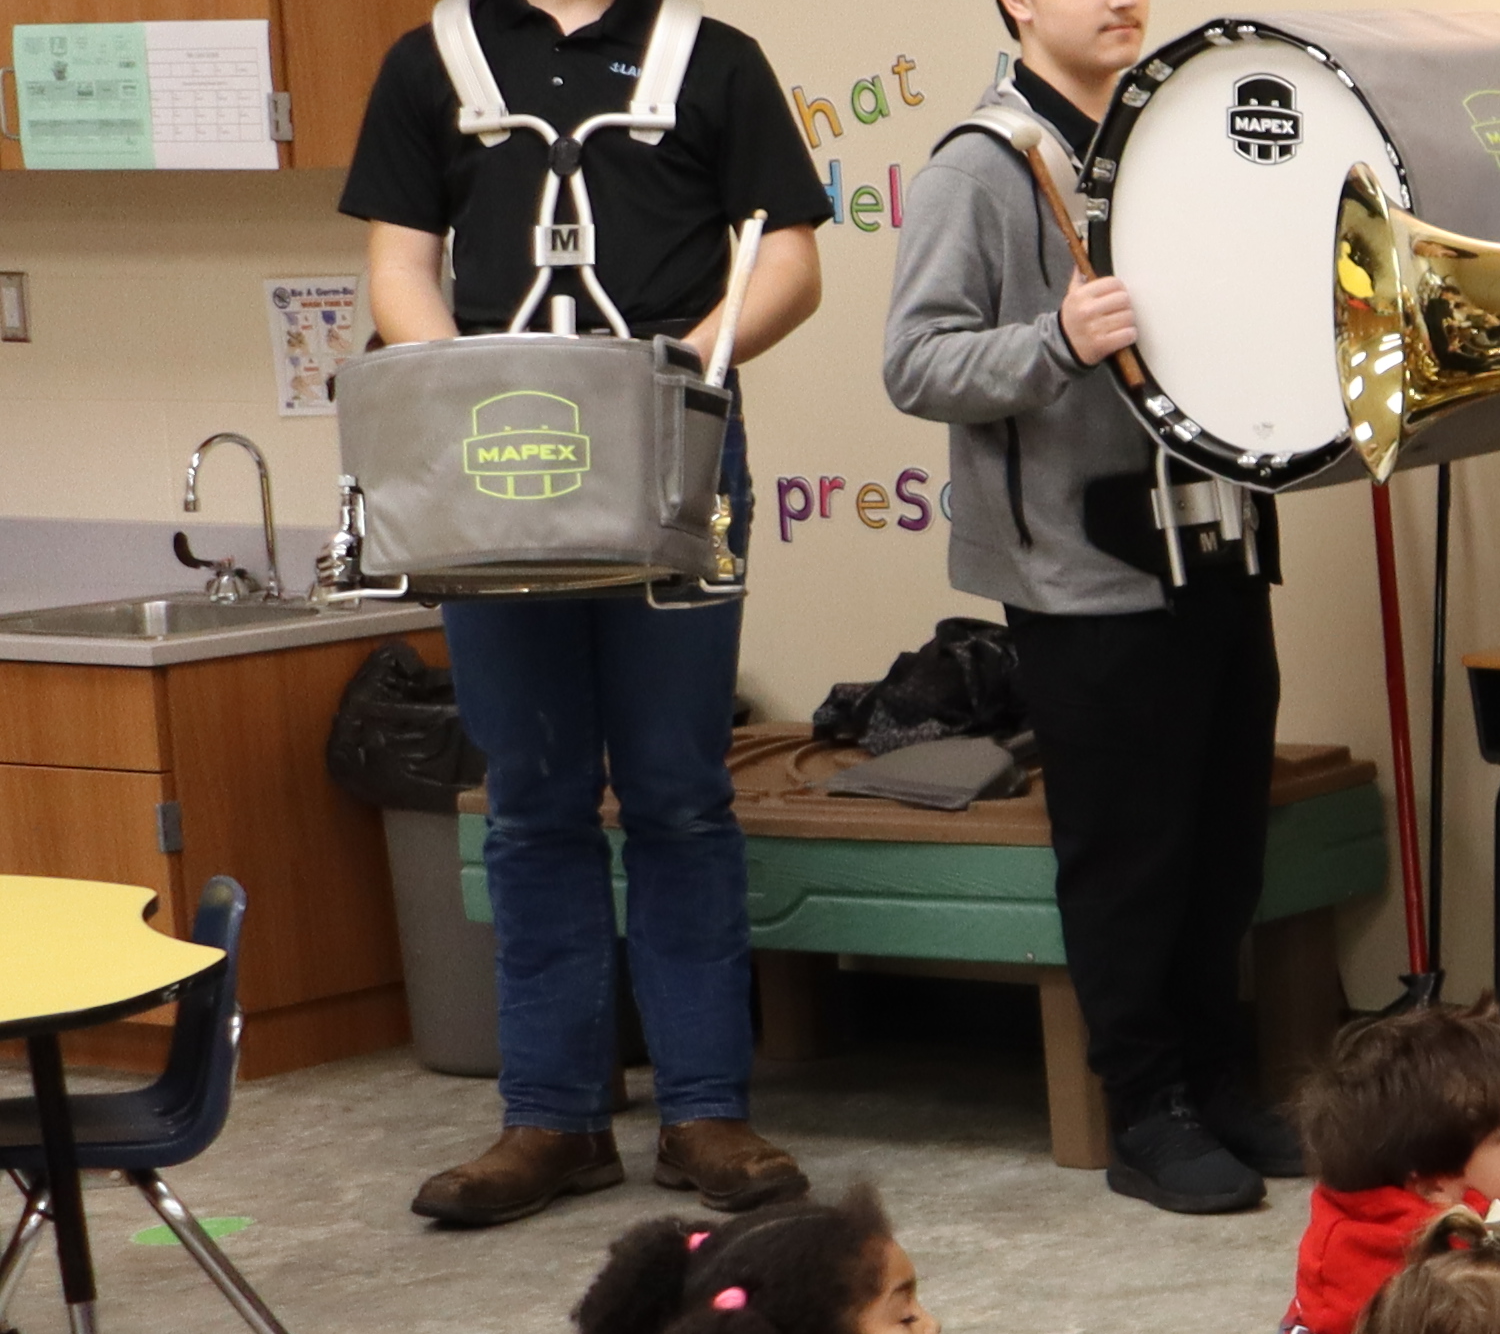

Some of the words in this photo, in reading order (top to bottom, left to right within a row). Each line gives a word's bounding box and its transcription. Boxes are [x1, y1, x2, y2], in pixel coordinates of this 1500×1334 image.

[793, 55, 925, 148] hat
[1234, 115, 1295, 136] MAPEX
[551, 228, 579, 252] M
[477, 444, 577, 464] MAPEX
